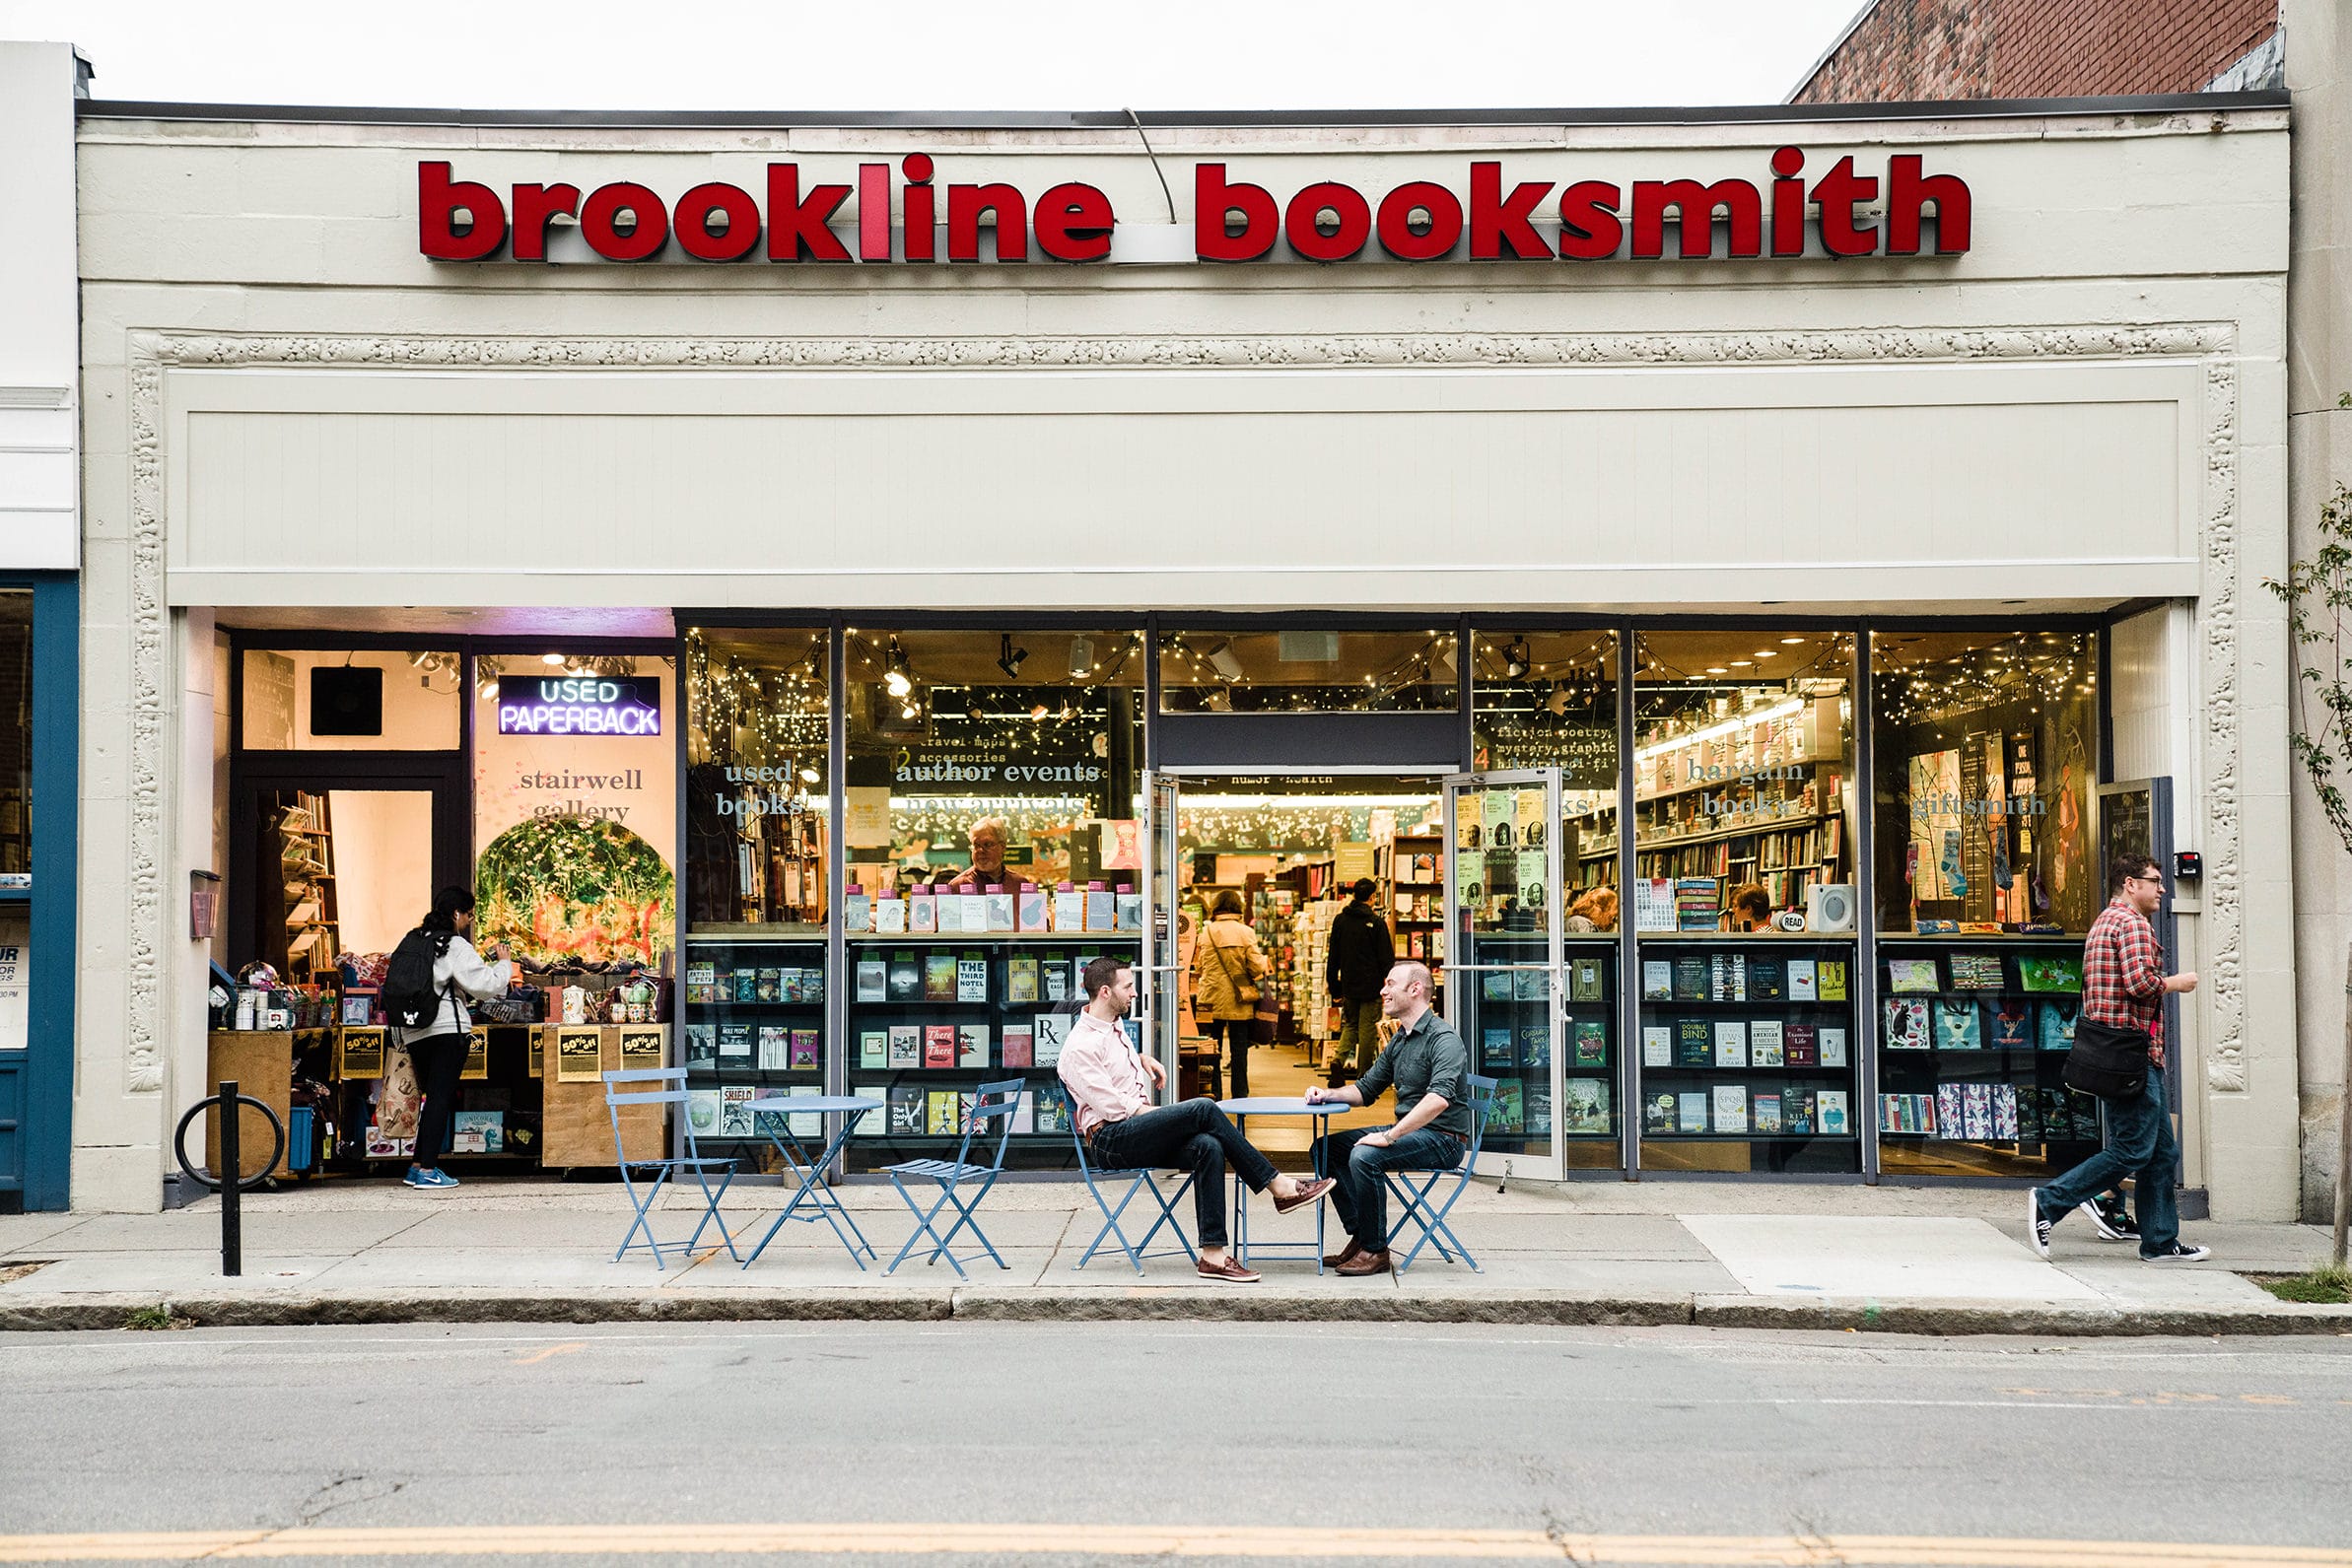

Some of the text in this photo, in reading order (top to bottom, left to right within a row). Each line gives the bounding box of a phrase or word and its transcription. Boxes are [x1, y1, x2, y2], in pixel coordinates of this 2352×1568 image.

[418, 146, 1972, 264] brookline booksmith
[540, 679, 619, 704] USED
[500, 706, 659, 734] PAPERBACK
[1497, 726, 1609, 740] fiction poetry
[919, 752, 1006, 763] accessories
[1474, 747, 1489, 770] 4
[1497, 741, 1617, 756] mystery graphic
[520, 769, 643, 789] stairwell
[724, 759, 794, 783] used
[896, 759, 997, 782] author
[1003, 760, 1101, 782] events
[1687, 758, 1805, 785] bargain
[533, 799, 630, 825] gallery
[716, 792, 802, 816] books
[905, 791, 1084, 816] new arrivals
[1703, 792, 1790, 815] books
[1911, 792, 2047, 820] giftsmith
[1784, 917, 1802, 927] READ
[959, 962, 984, 973] THE
[346, 1035, 380, 1051] 50% off
[562, 1035, 596, 1053] 50% off
[624, 1035, 658, 1052] 50% off
[928, 1030, 952, 1041] There
[1682, 1030, 1707, 1040] BIND
[928, 1045, 952, 1056] There
[725, 1088, 752, 1100] SHIELD
